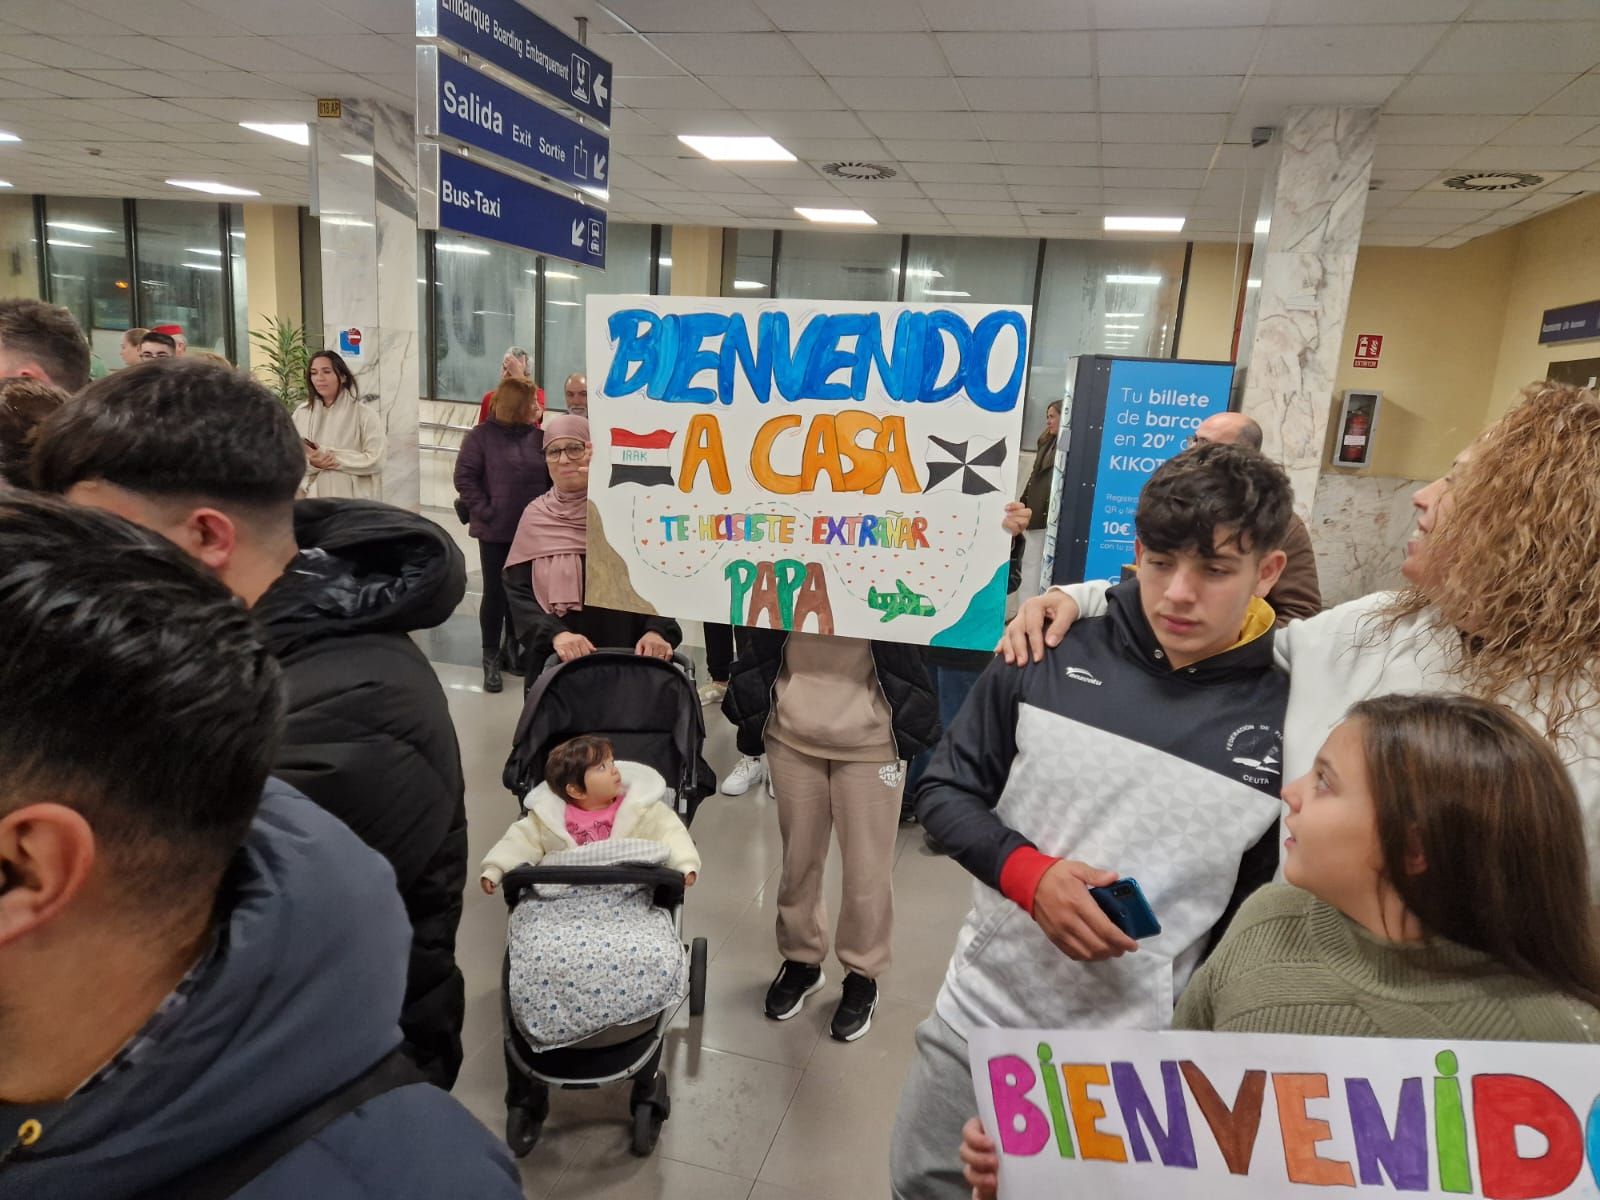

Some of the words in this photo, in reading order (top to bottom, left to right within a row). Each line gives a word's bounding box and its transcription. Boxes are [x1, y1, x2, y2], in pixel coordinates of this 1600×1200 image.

[441, 0, 490, 33] mbarque
[493, 20, 523, 58] Boarding
[525, 40, 569, 80] Embarquement
[443, 81, 503, 135] Salida
[512, 124, 532, 148] Exit
[539, 137, 566, 162] Sortie
[442, 180, 501, 218] Bus-Taxi
[604, 309, 1027, 412] BIENVENIDO
[1121, 387, 1143, 403] Tu
[1148, 388, 1210, 408] billete
[1117, 409, 1140, 425] de
[1145, 410, 1202, 429] barco
[622, 450, 648, 463] IRAK
[679, 414, 732, 494] A
[750, 410, 922, 495] CASA
[1113, 433, 1136, 447] en
[659, 515, 690, 542] TE
[811, 510, 930, 550] EXTRAÑAR
[1102, 521, 1131, 536] 10€
[725, 559, 835, 635] PAPA
[1243, 774, 1270, 785] CEUTA
